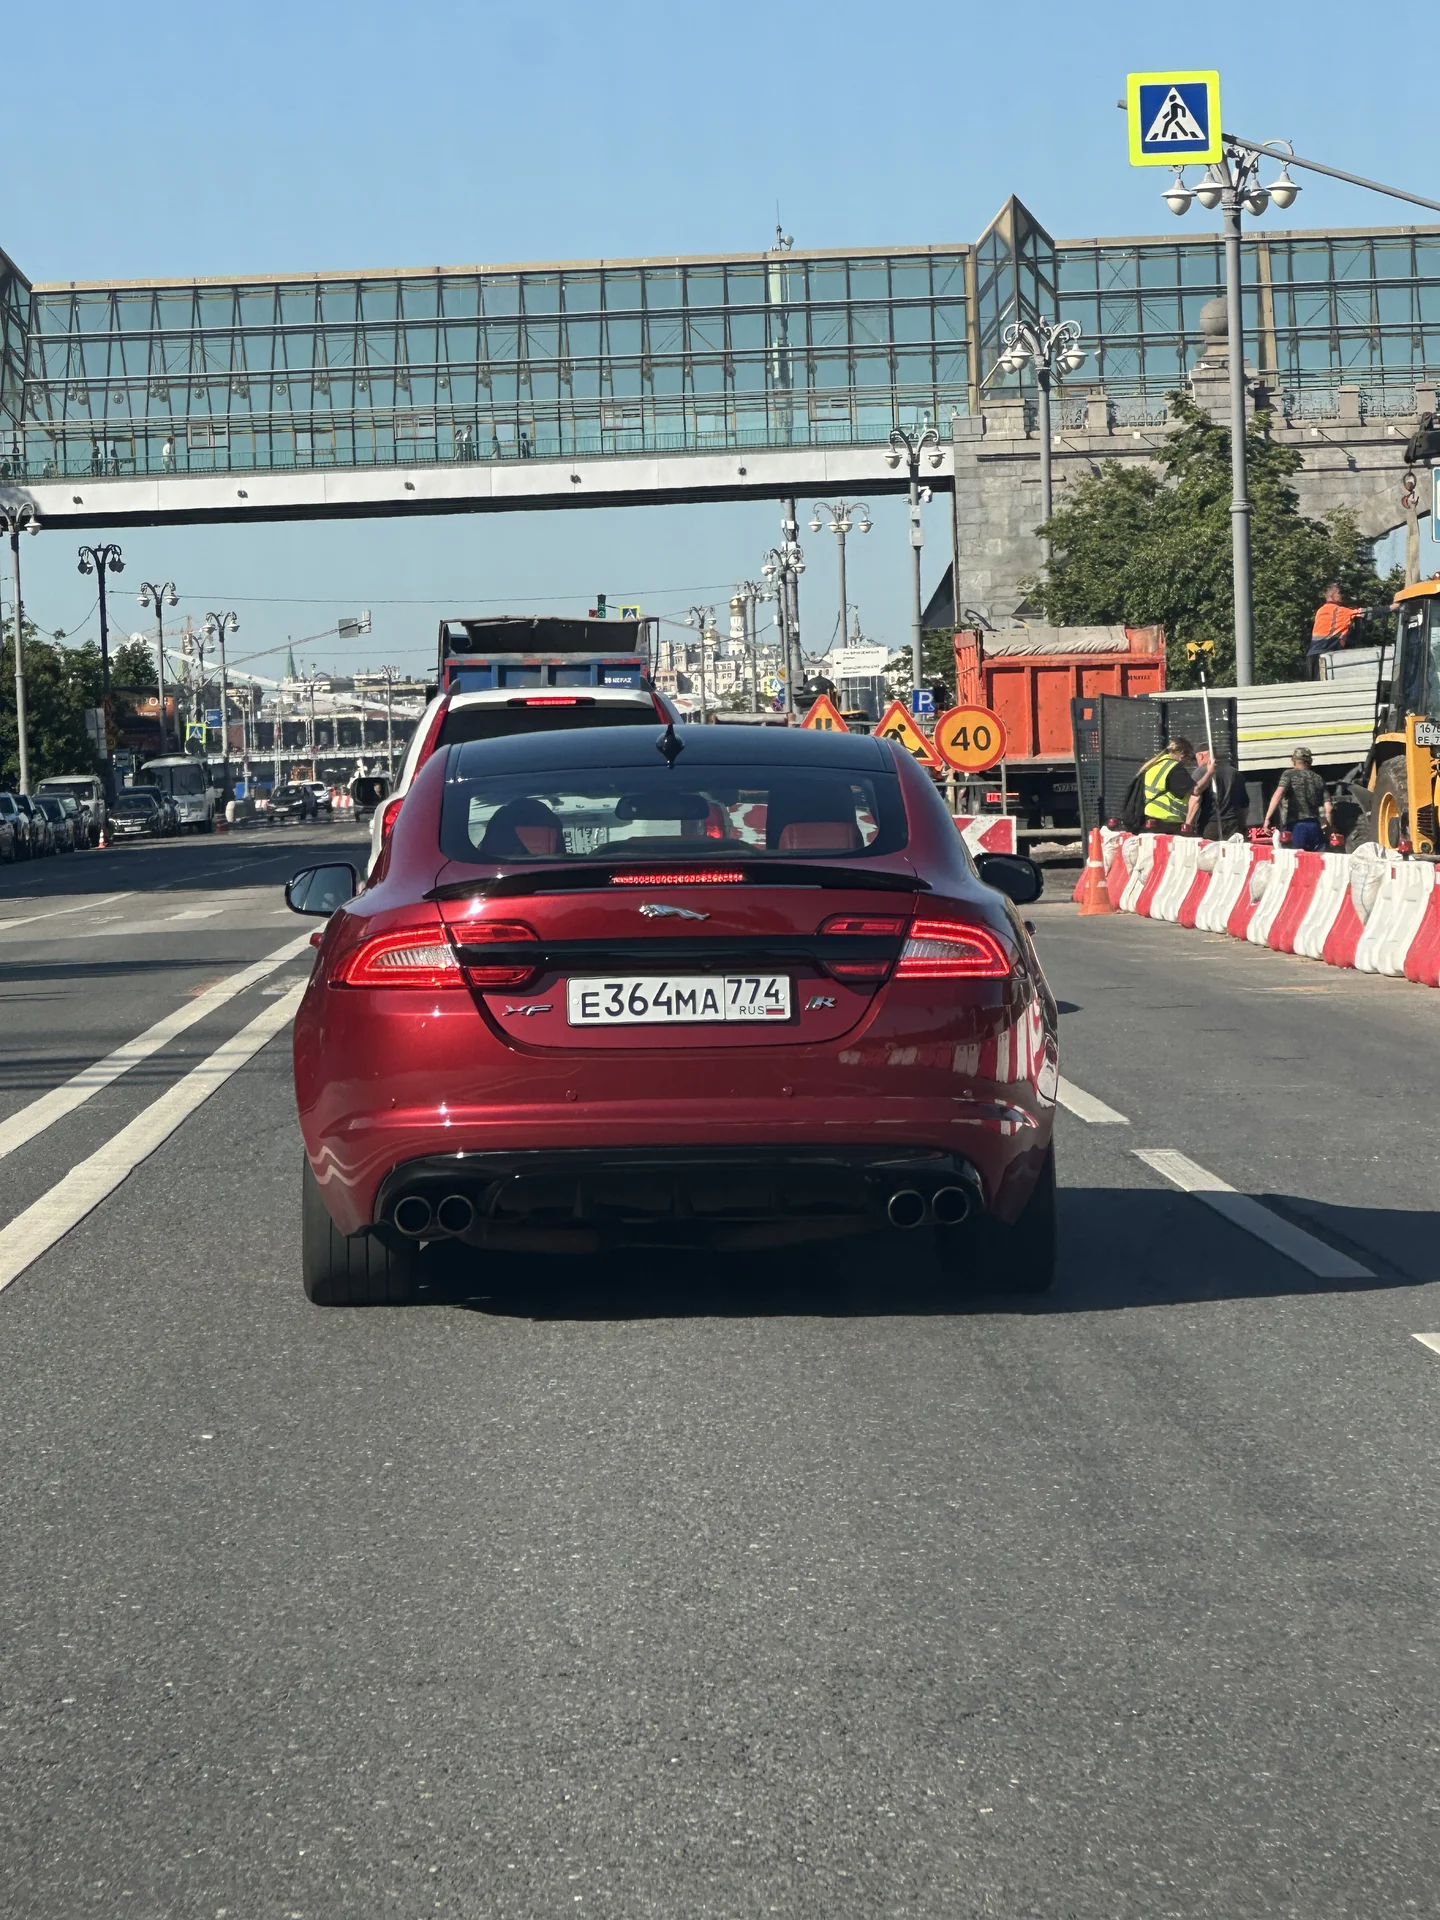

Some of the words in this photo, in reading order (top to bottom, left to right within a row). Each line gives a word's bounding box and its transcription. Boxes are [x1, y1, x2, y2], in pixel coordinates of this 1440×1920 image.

[918, 692, 934, 711] P
[950, 725, 991, 751] 40
[727, 978, 780, 1005] 774
[502, 1004, 552, 1016] XF
[739, 1005, 764, 1015] RUS
